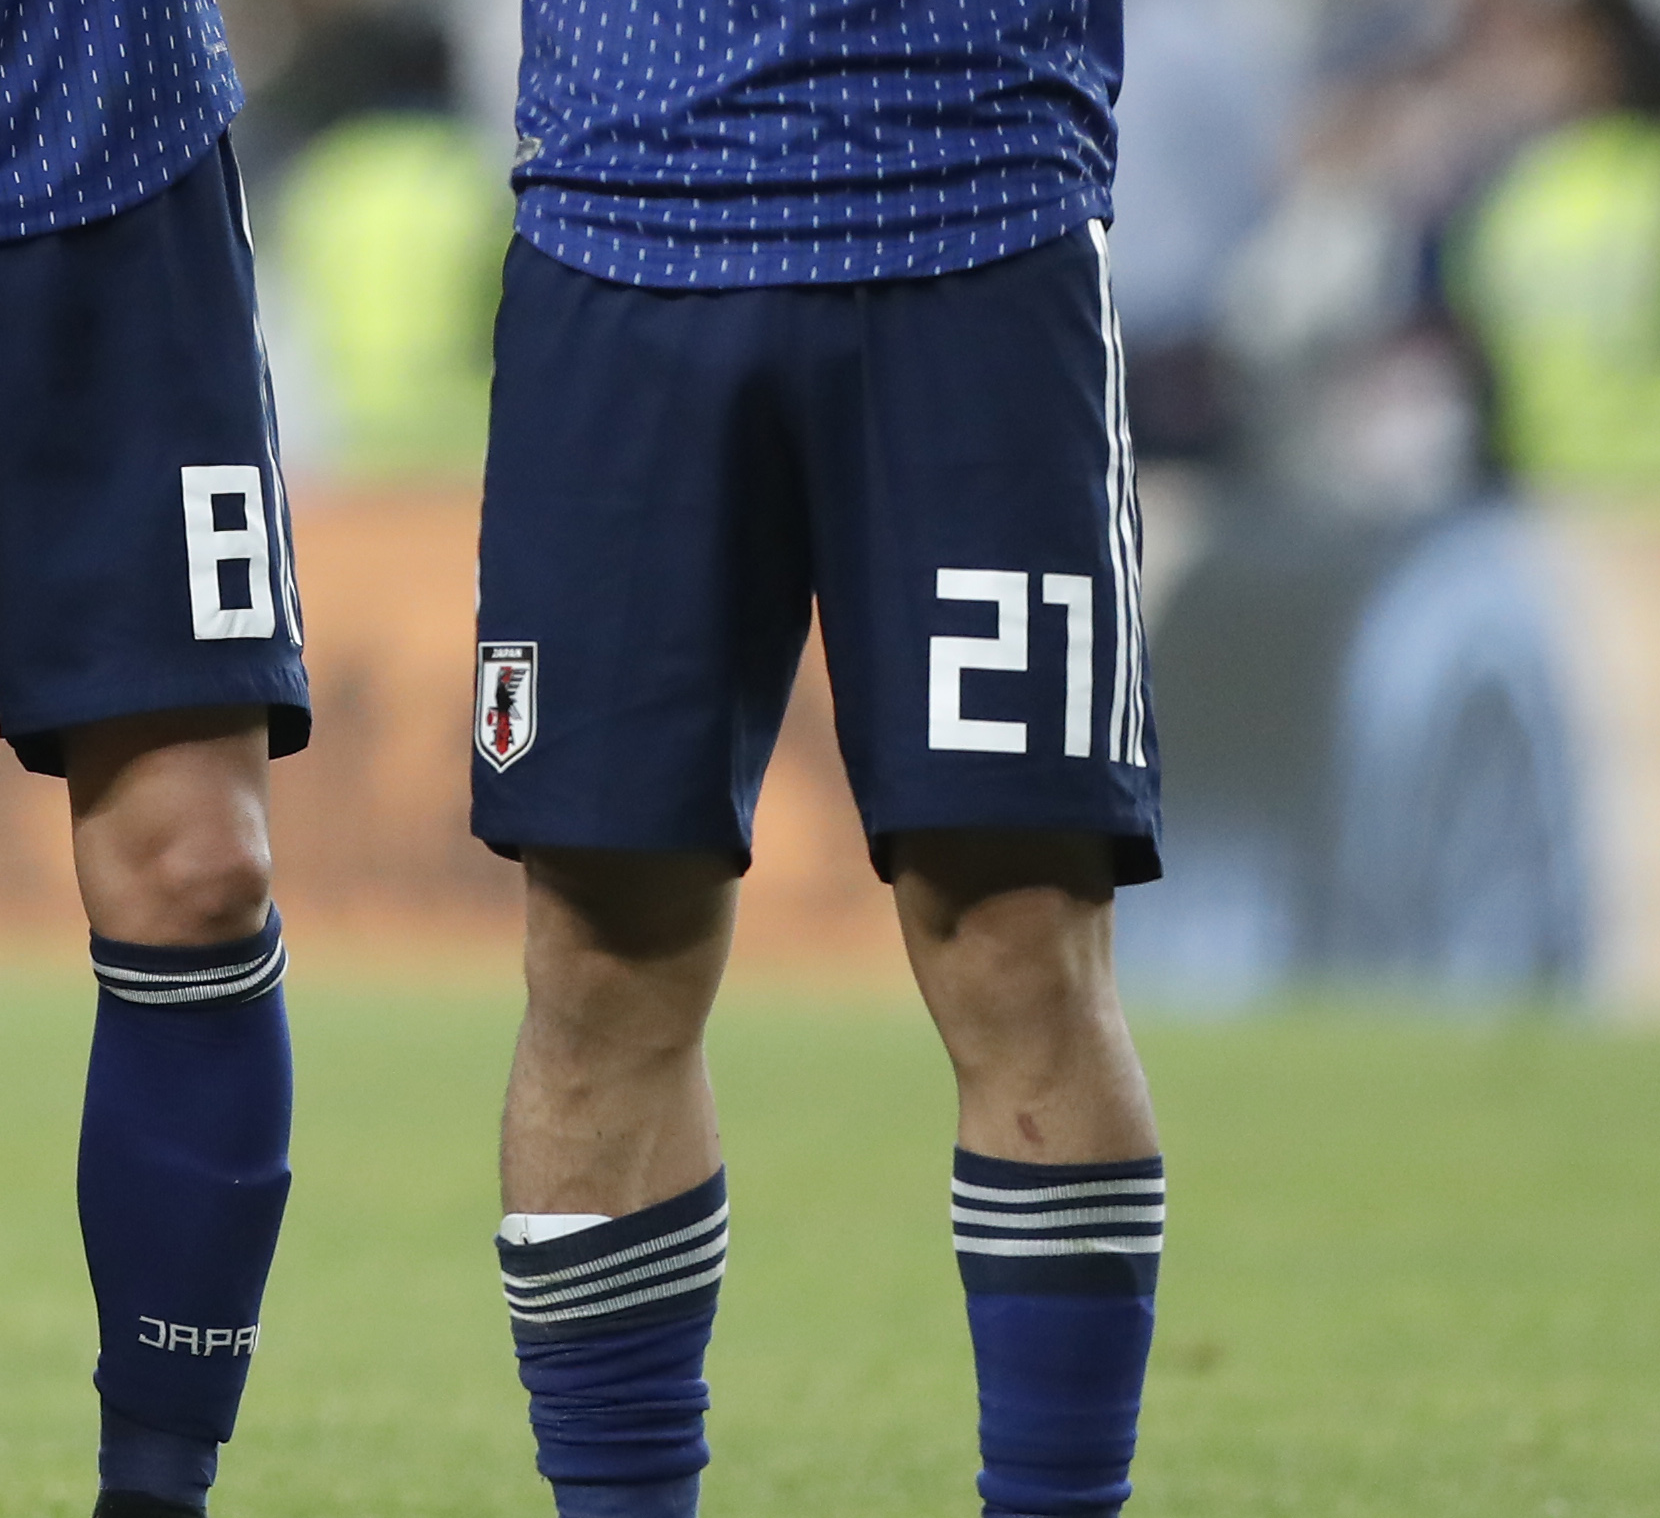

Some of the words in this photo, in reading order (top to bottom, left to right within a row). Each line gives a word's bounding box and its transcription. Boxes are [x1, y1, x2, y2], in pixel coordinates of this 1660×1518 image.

[181, 465, 276, 641] 8
[928, 568, 1093, 758] 21
[138, 1315, 261, 1357] JAPA
